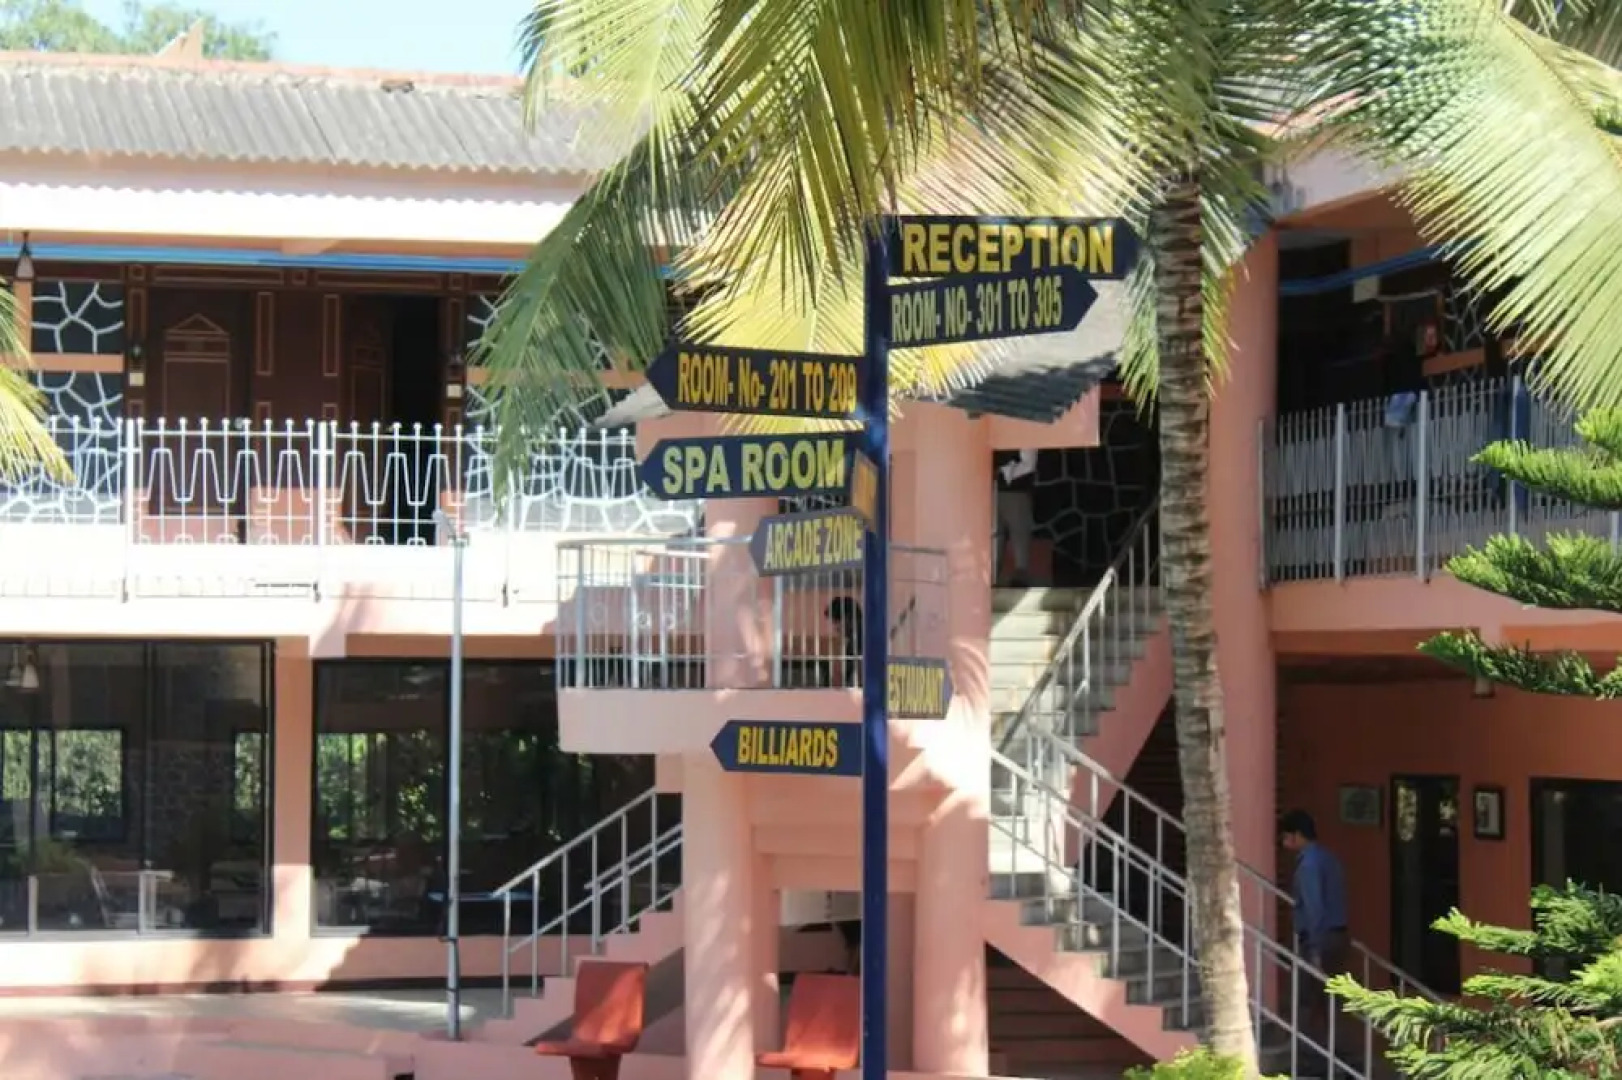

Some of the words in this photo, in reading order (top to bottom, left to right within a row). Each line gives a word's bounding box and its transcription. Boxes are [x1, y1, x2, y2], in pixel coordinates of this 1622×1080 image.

[903, 223, 1114, 274] RECEPTION
[976, 281, 1003, 334] 301
[1008, 277, 1030, 330] TO
[1034, 275, 1063, 327] 305
[769, 359, 797, 411] 201
[803, 361, 824, 412] TO
[661, 445, 731, 495] SPA
[741, 439, 845, 492] ROOM
[763, 518, 821, 570] ARCADE
[823, 514, 863, 564] ZONE
[887, 664, 944, 715] ESTAURANT
[738, 726, 838, 767] BILLIARDS
